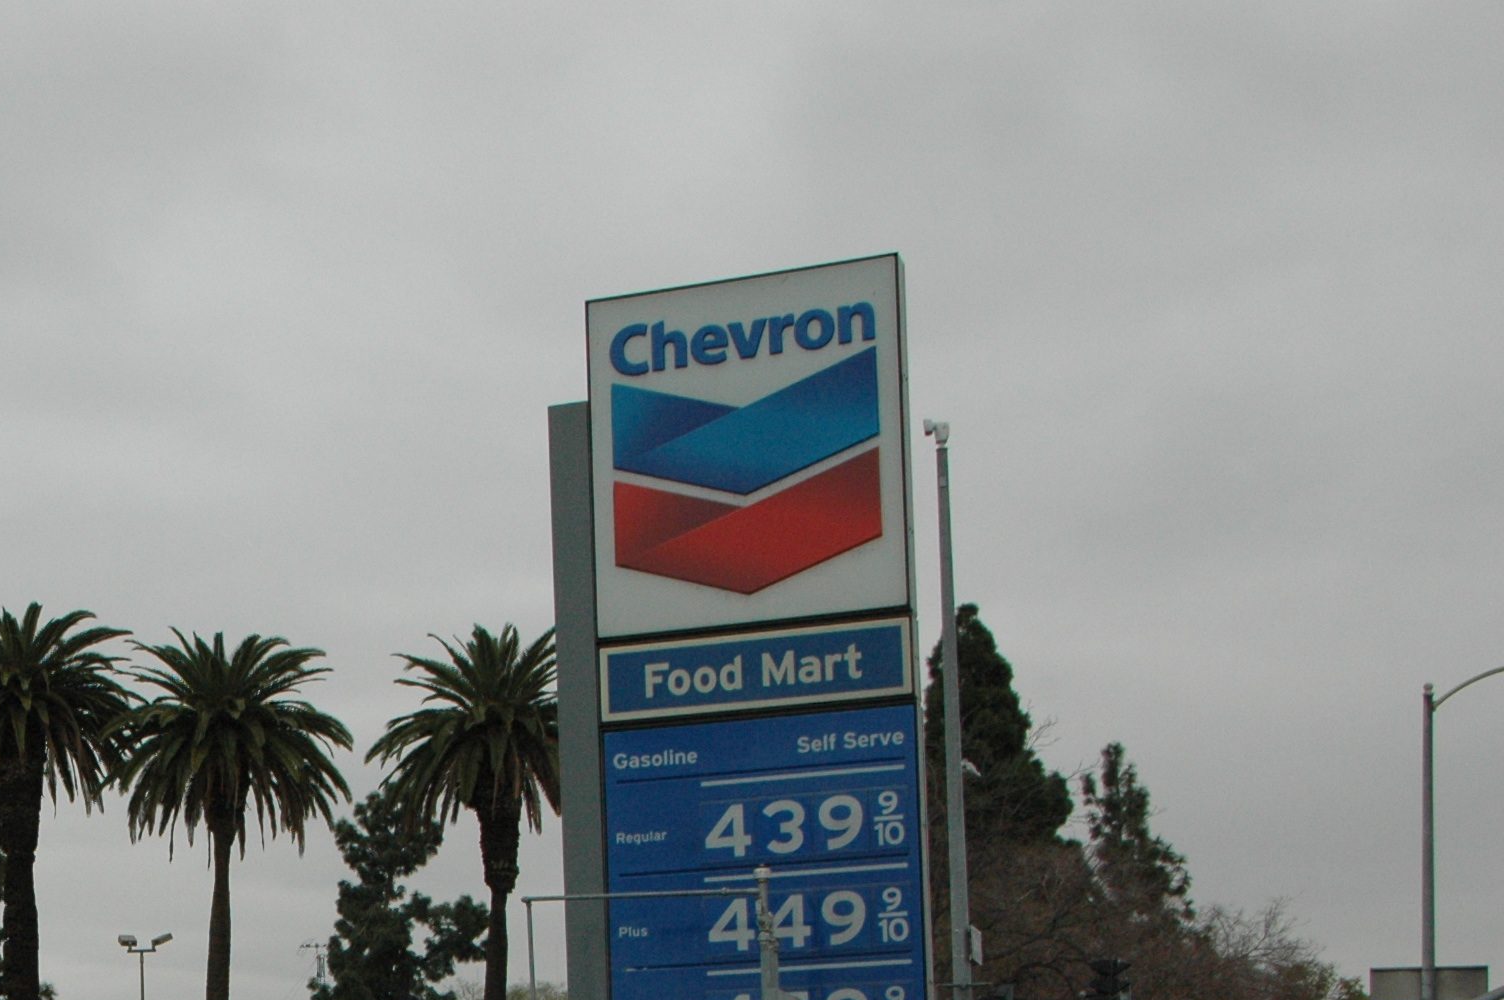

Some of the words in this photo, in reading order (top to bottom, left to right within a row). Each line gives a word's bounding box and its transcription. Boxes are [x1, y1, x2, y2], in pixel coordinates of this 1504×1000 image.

[609, 302, 876, 376] Chevron
[645, 655, 743, 698] Food
[761, 643, 863, 687] Mart
[613, 749, 698, 769] Gasoline
[797, 733, 836, 753] Self
[843, 731, 904, 749] Serve
[616, 831, 668, 845] Regular
[705, 795, 863, 857] 439
[618, 926, 649, 938] Plus
[708, 890, 866, 951] 449
